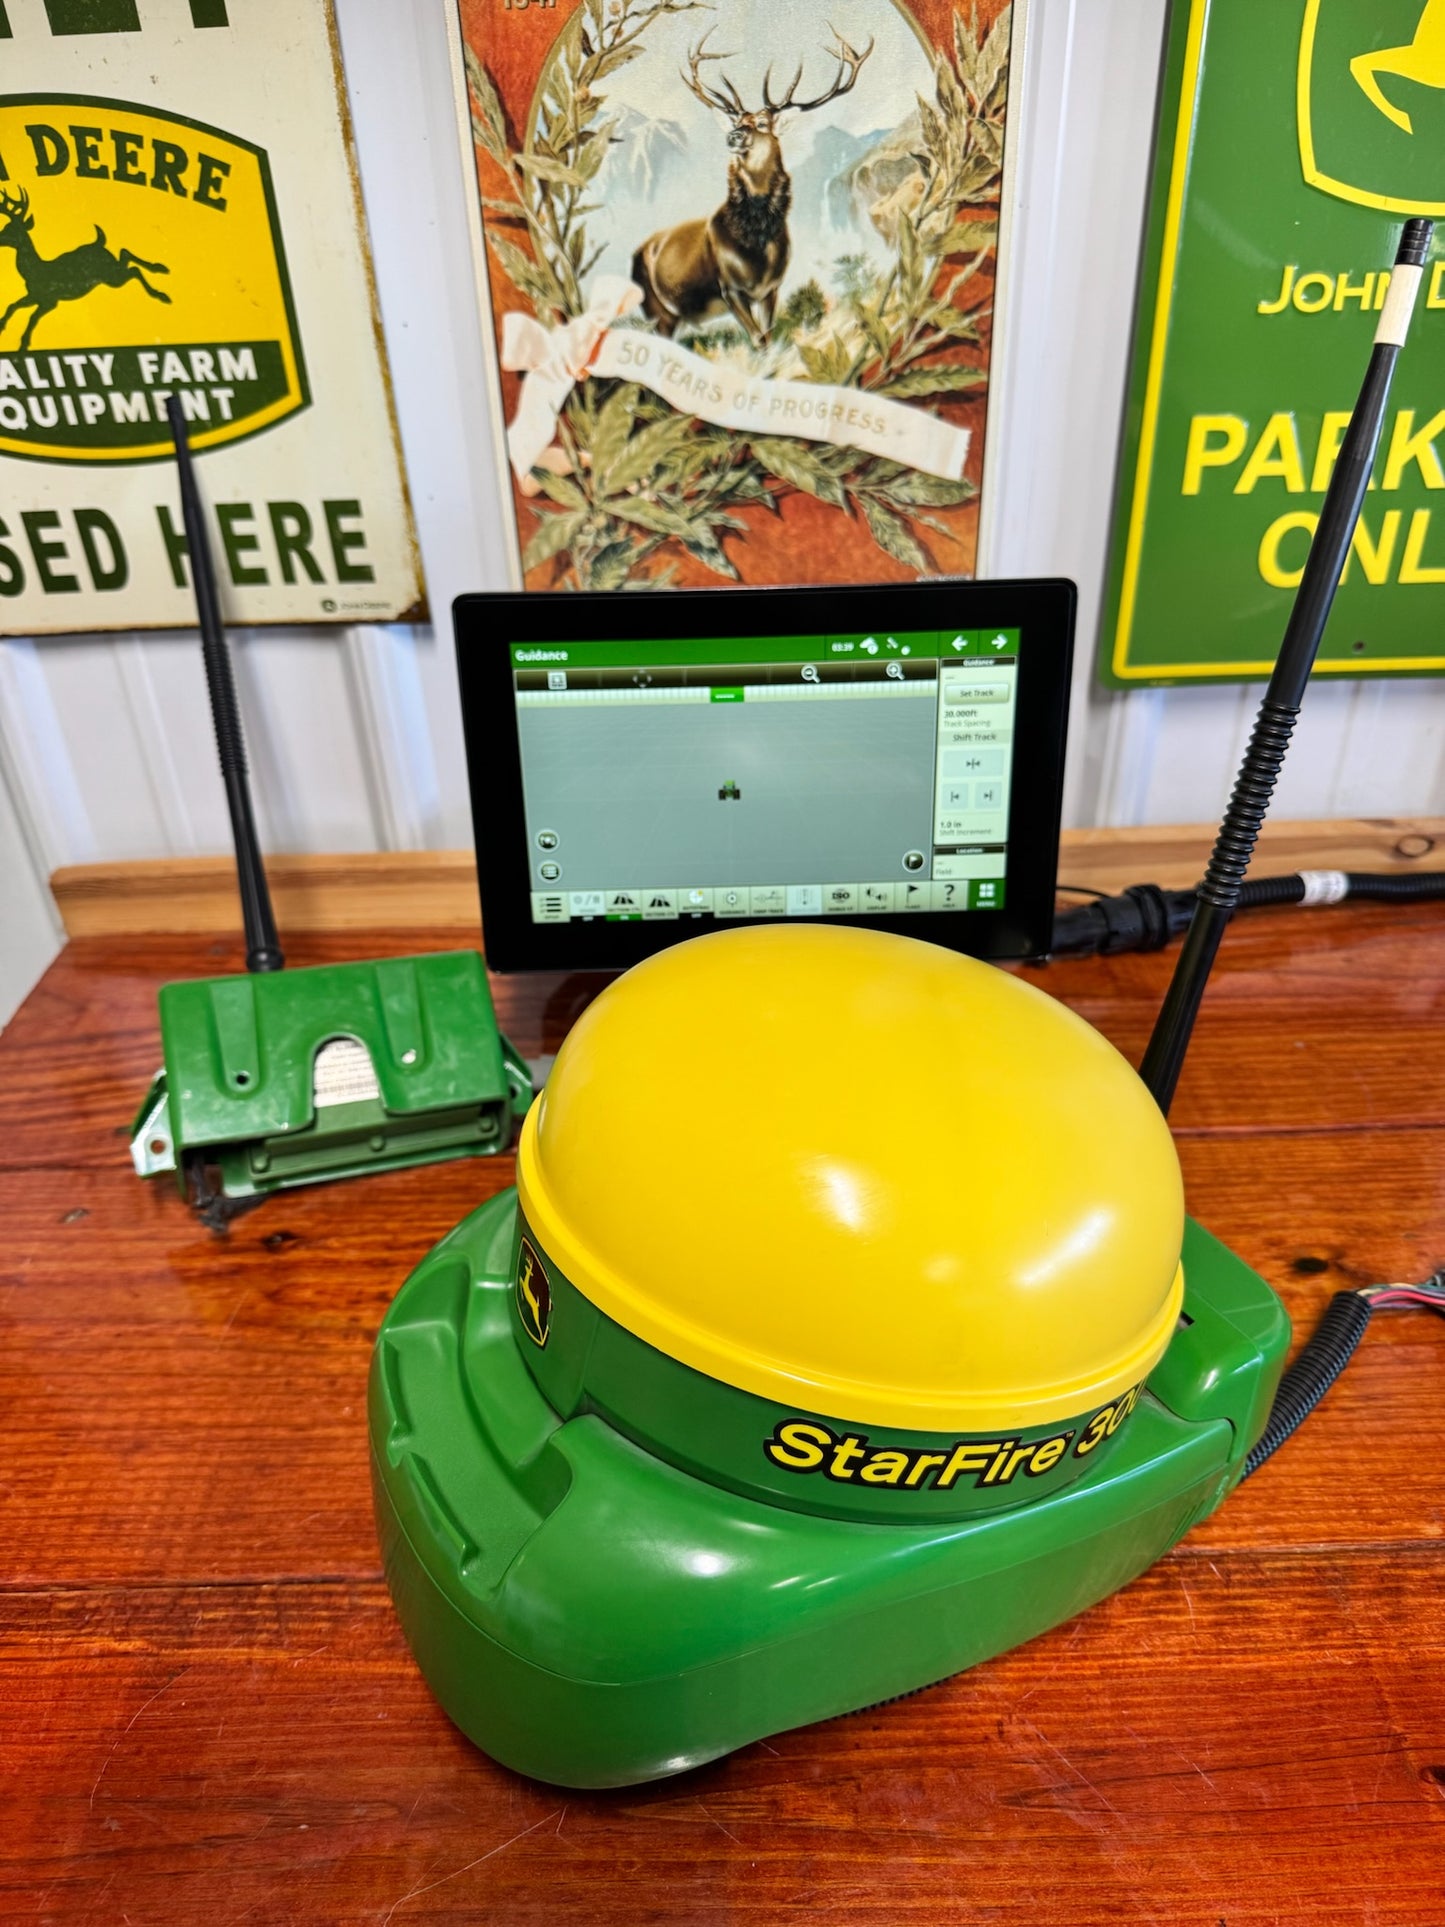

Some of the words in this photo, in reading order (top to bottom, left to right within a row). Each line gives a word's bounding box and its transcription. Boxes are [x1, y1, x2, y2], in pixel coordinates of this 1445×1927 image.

[25, 124, 231, 213] DEERE
[0, 352, 114, 391] ALITY
[137, 348, 258, 385] FARM
[616, 340, 649, 367] 50
[658, 354, 723, 403] YEARS
[732, 394, 761, 413] OF
[515, 649, 569, 662] Guidance
[974, 689, 994, 697] Track
[953, 733, 972, 742] Shift
[974, 733, 997, 741] Track
